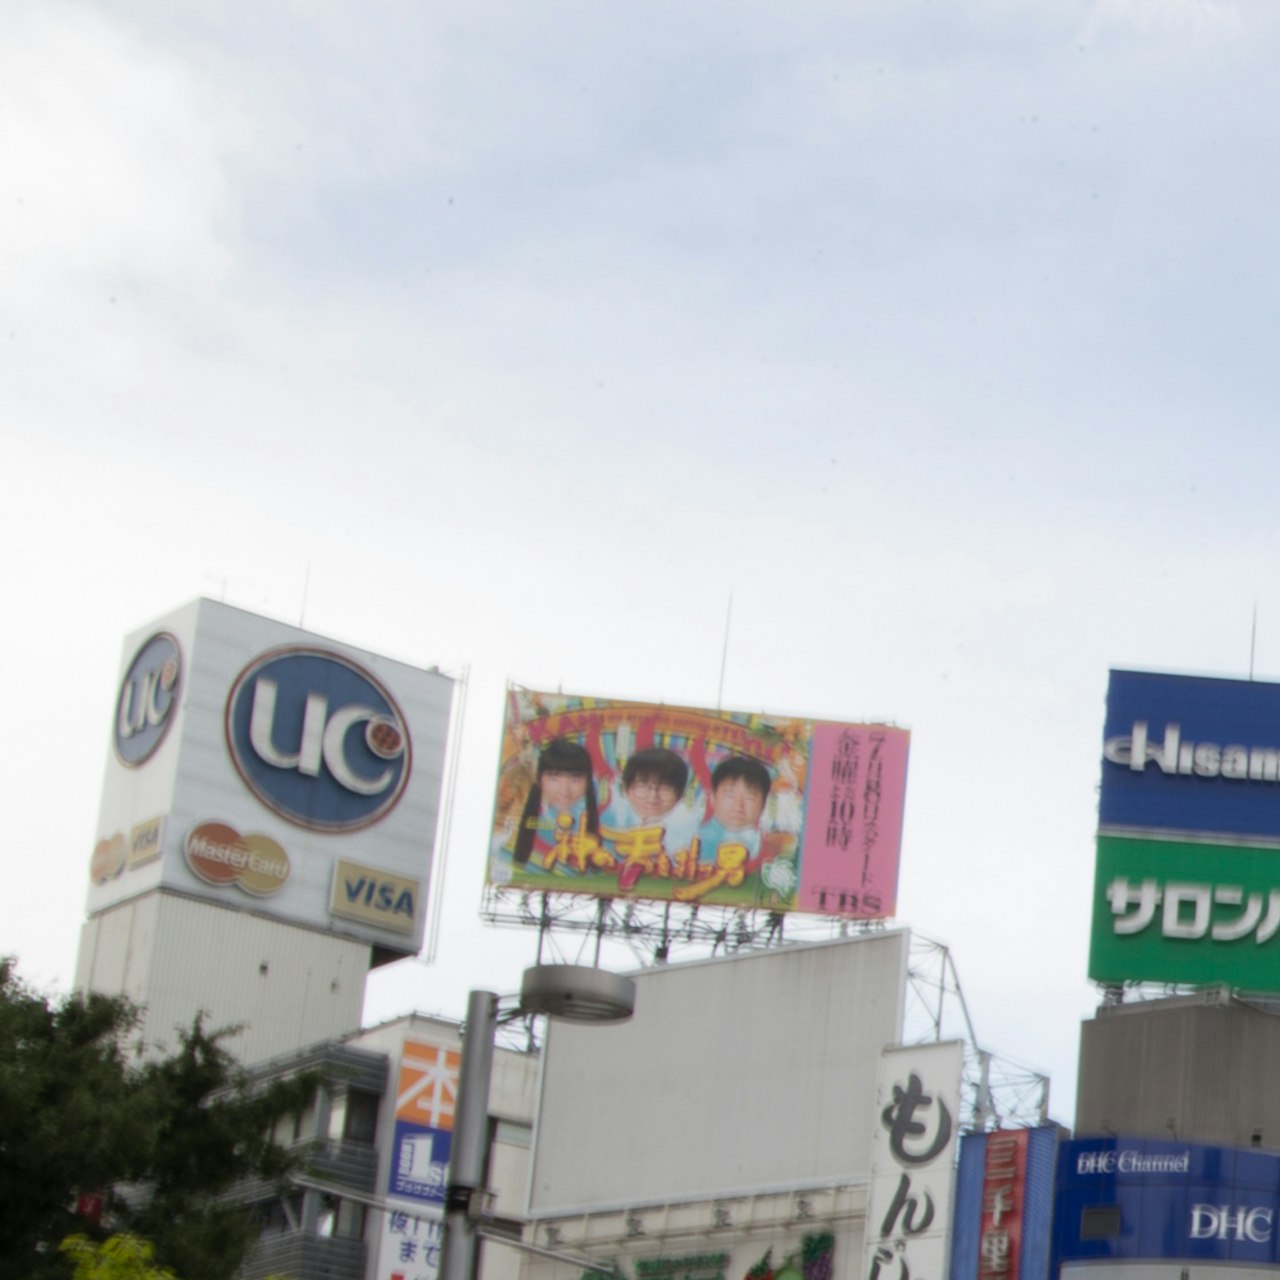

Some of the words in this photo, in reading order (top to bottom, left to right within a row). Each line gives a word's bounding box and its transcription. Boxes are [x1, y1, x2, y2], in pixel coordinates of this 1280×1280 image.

[249, 675, 398, 796] UC
[189, 833, 289, 877] MasterCard
[345, 874, 416, 919] VISA
[811, 885, 882, 915] TBS
[394, 1048, 461, 1128] 本
[1076, 1150, 1116, 1176] DHC
[1117, 1148, 1190, 1174] Channel
[1188, 1202, 1275, 1244] DHC
